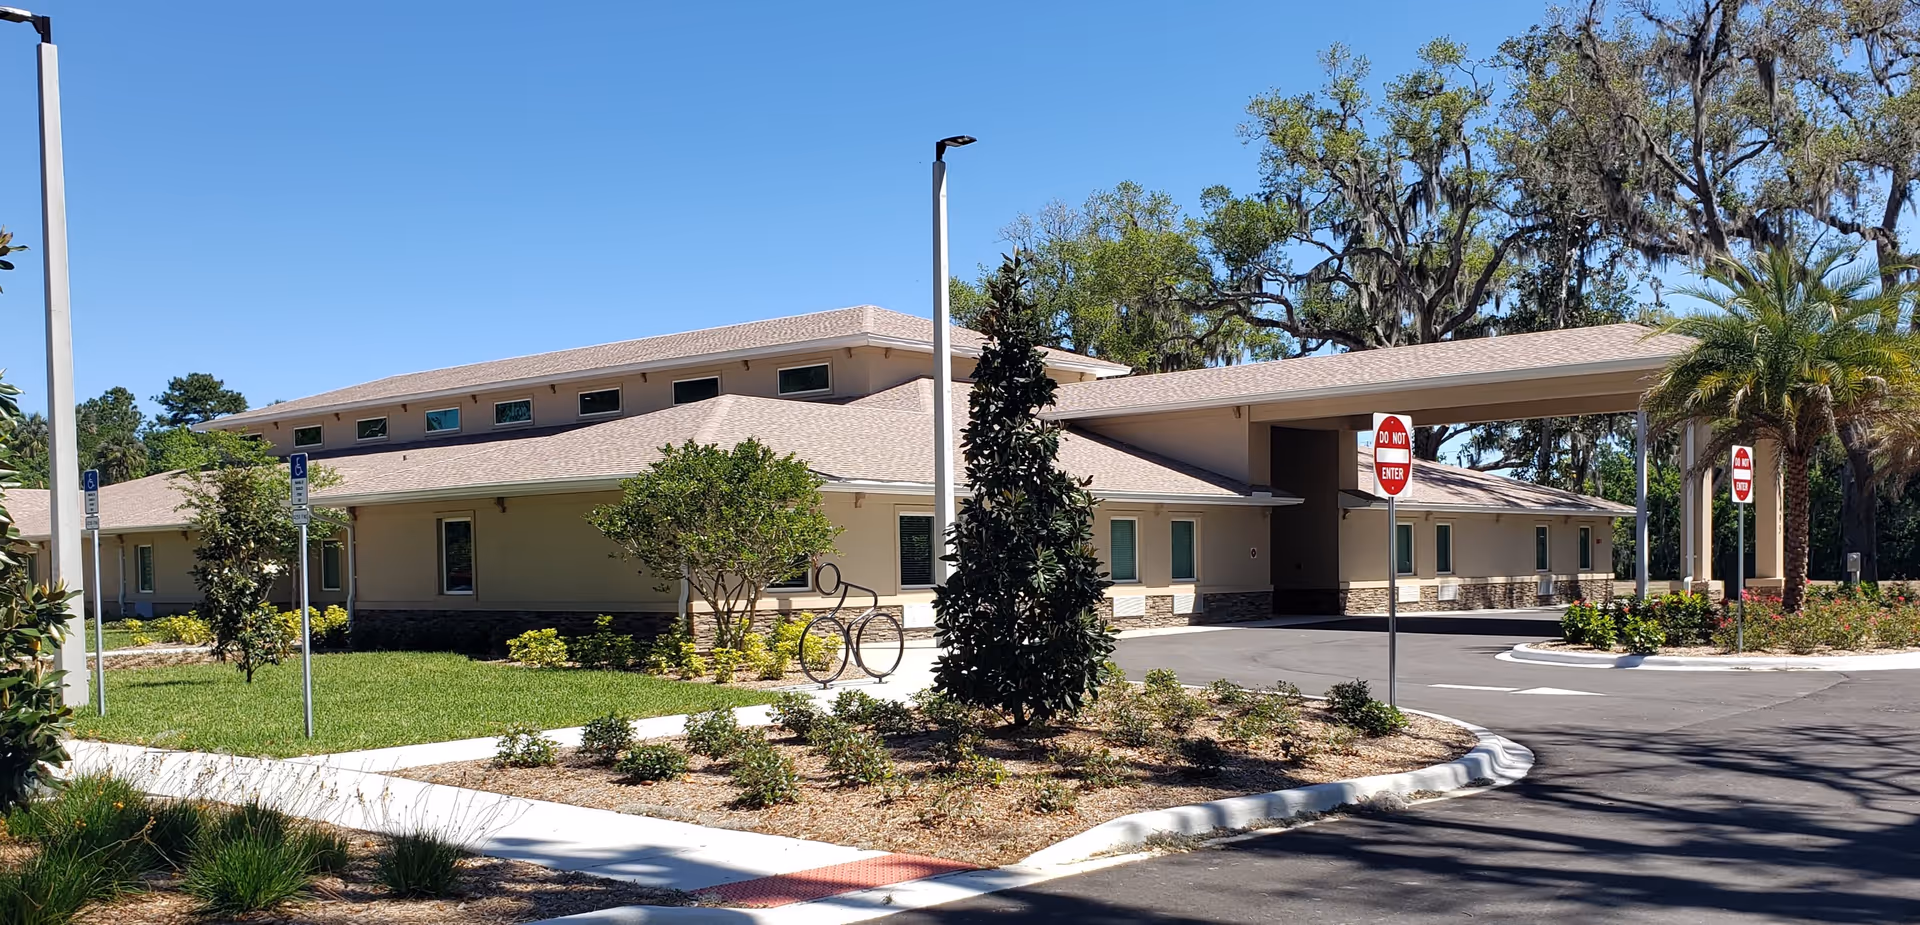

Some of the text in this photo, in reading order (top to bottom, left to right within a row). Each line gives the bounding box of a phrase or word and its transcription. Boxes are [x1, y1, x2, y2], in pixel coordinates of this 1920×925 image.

[1380, 431, 1406, 445] DO NOT
[1735, 457, 1749, 467] DO NOT
[1382, 467, 1404, 480] ENTER
[1736, 481, 1748, 491] ENTER
